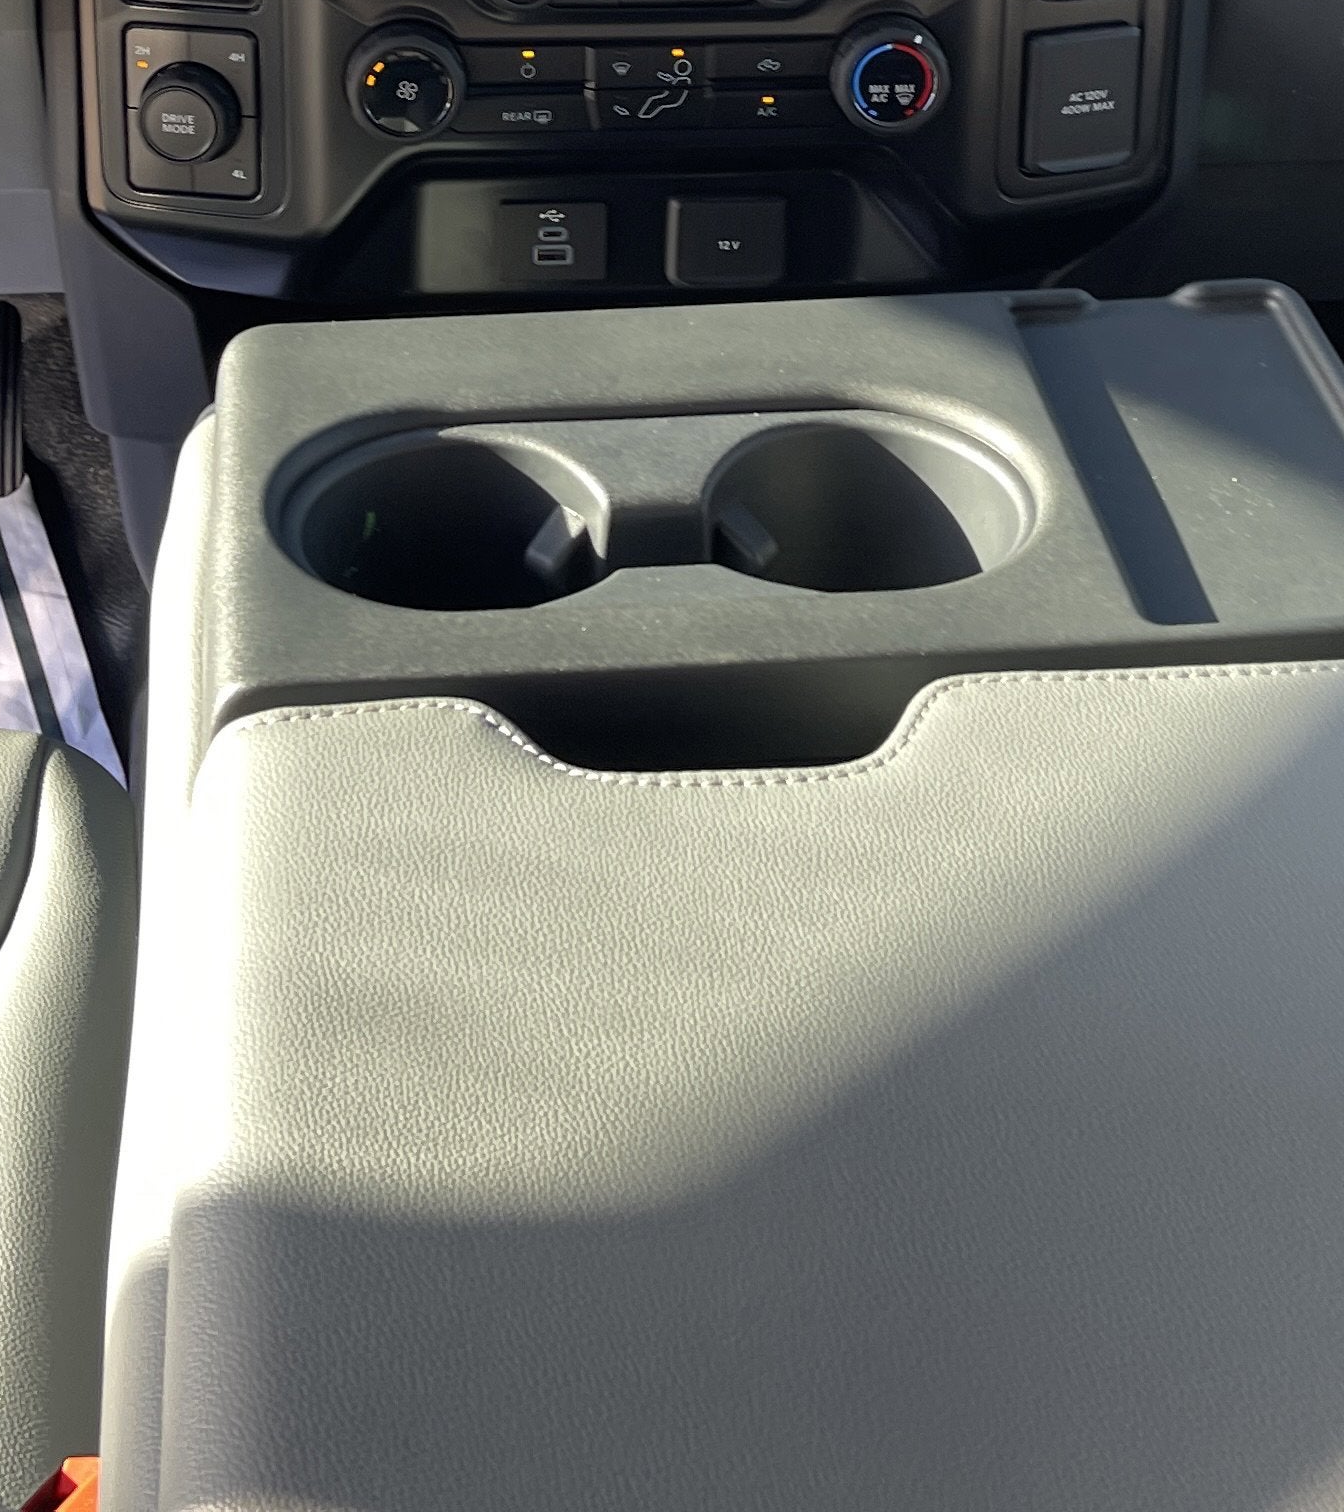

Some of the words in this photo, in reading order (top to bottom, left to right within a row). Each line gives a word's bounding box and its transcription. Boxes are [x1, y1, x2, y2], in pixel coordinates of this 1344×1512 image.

[161, 112, 196, 125] DRIVE
[502, 110, 533, 122] REAR
[161, 123, 197, 135] MODE
